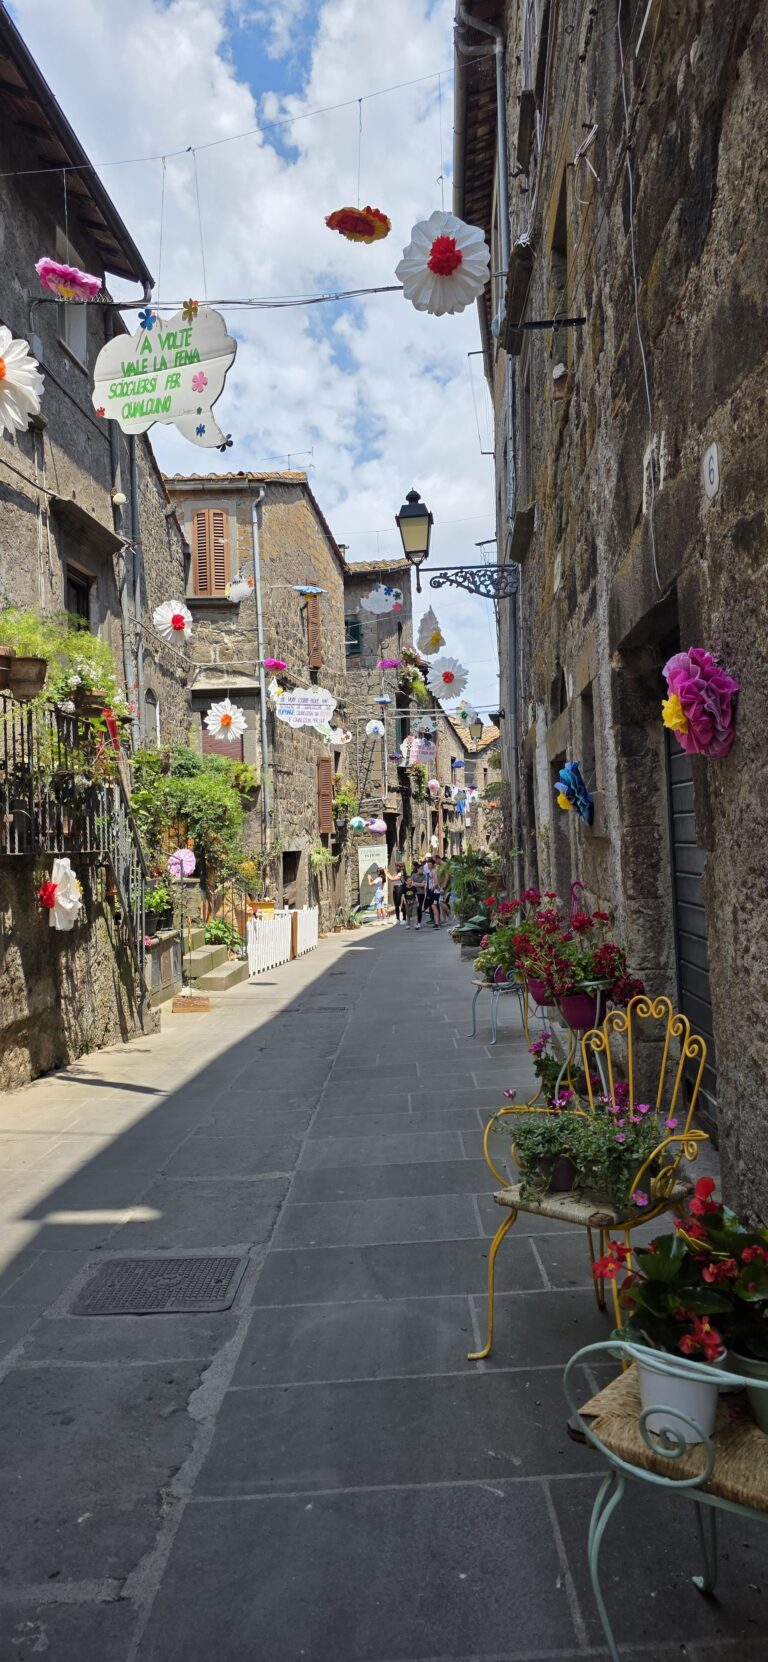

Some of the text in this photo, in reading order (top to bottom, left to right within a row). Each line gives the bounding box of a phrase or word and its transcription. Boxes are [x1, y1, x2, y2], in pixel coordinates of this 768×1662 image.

[139, 328, 193, 355] A VOLTE
[121, 348, 201, 377] VALE LA PENA
[164, 372, 181, 391] PER
[121, 395, 172, 420] QUALCUNO
[708, 456, 715, 485] 6
